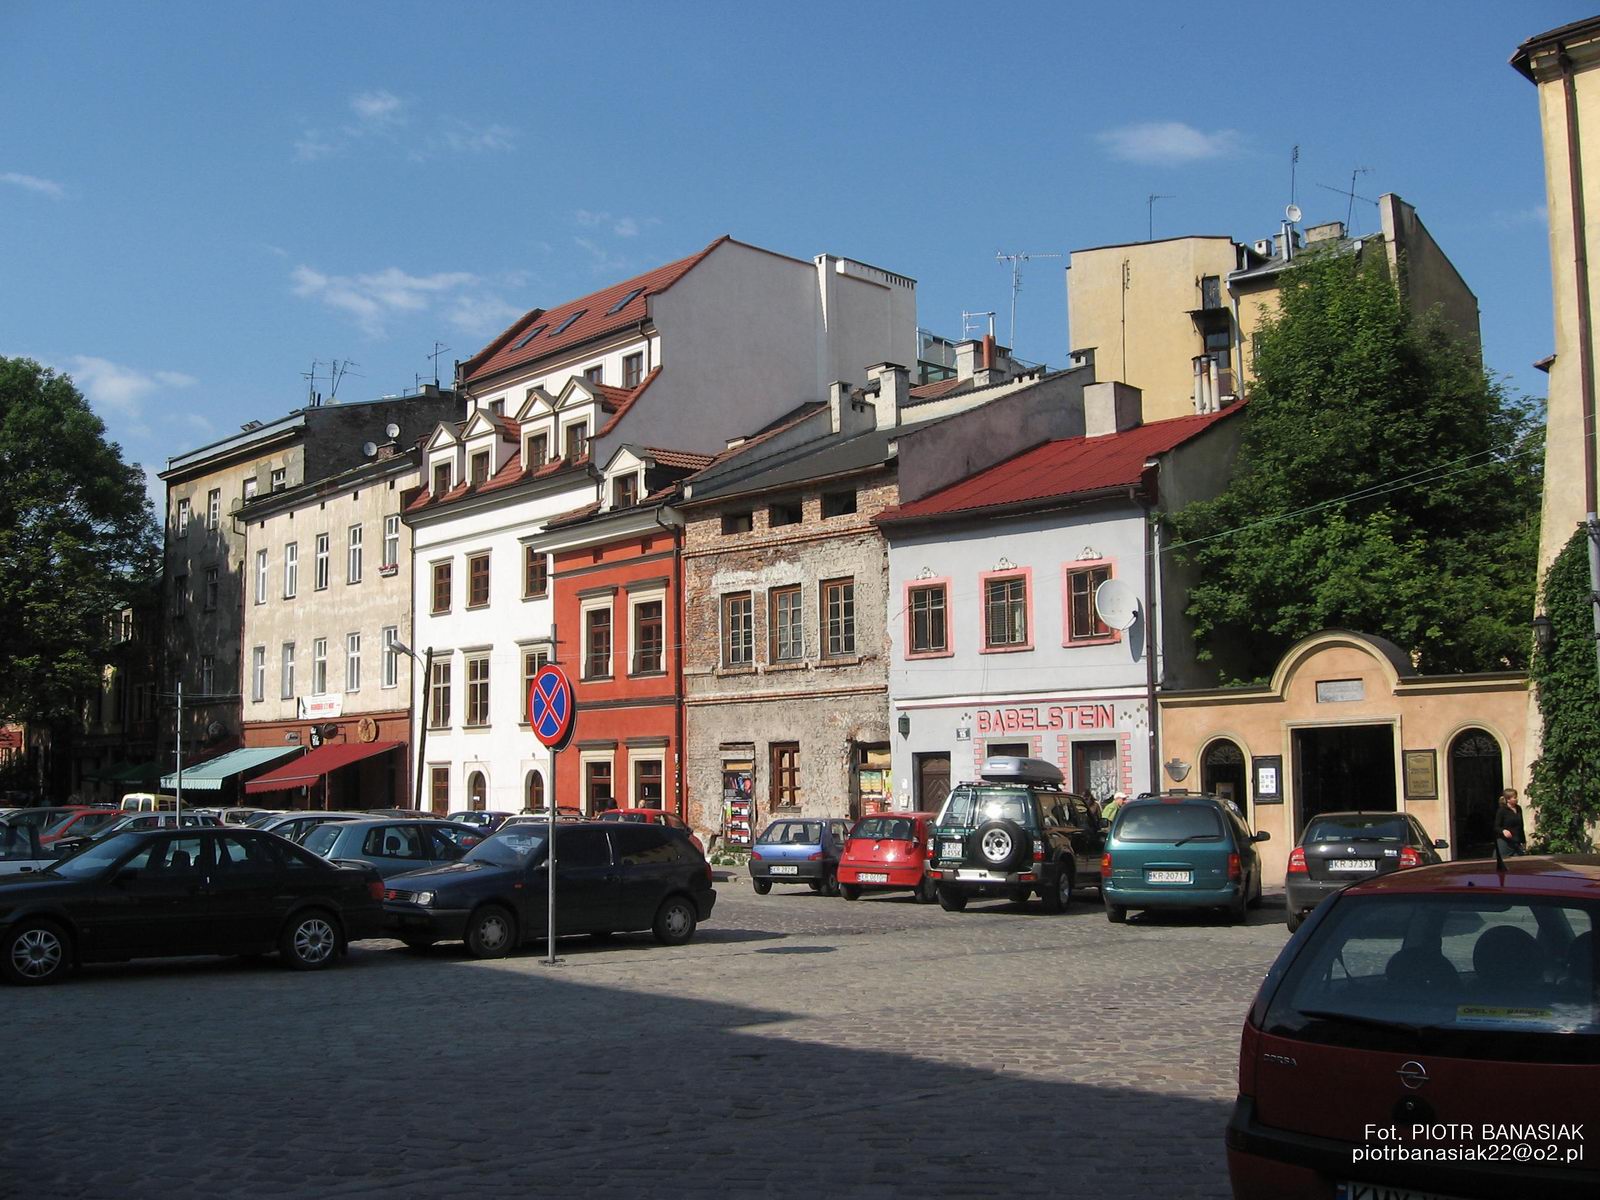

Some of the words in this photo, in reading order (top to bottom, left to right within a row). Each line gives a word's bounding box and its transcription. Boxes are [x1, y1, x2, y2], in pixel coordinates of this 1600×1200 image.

[1334, 860, 1346, 868] KR
[1153, 872, 1164, 880] KR
[1165, 872, 1188, 880] 20717
